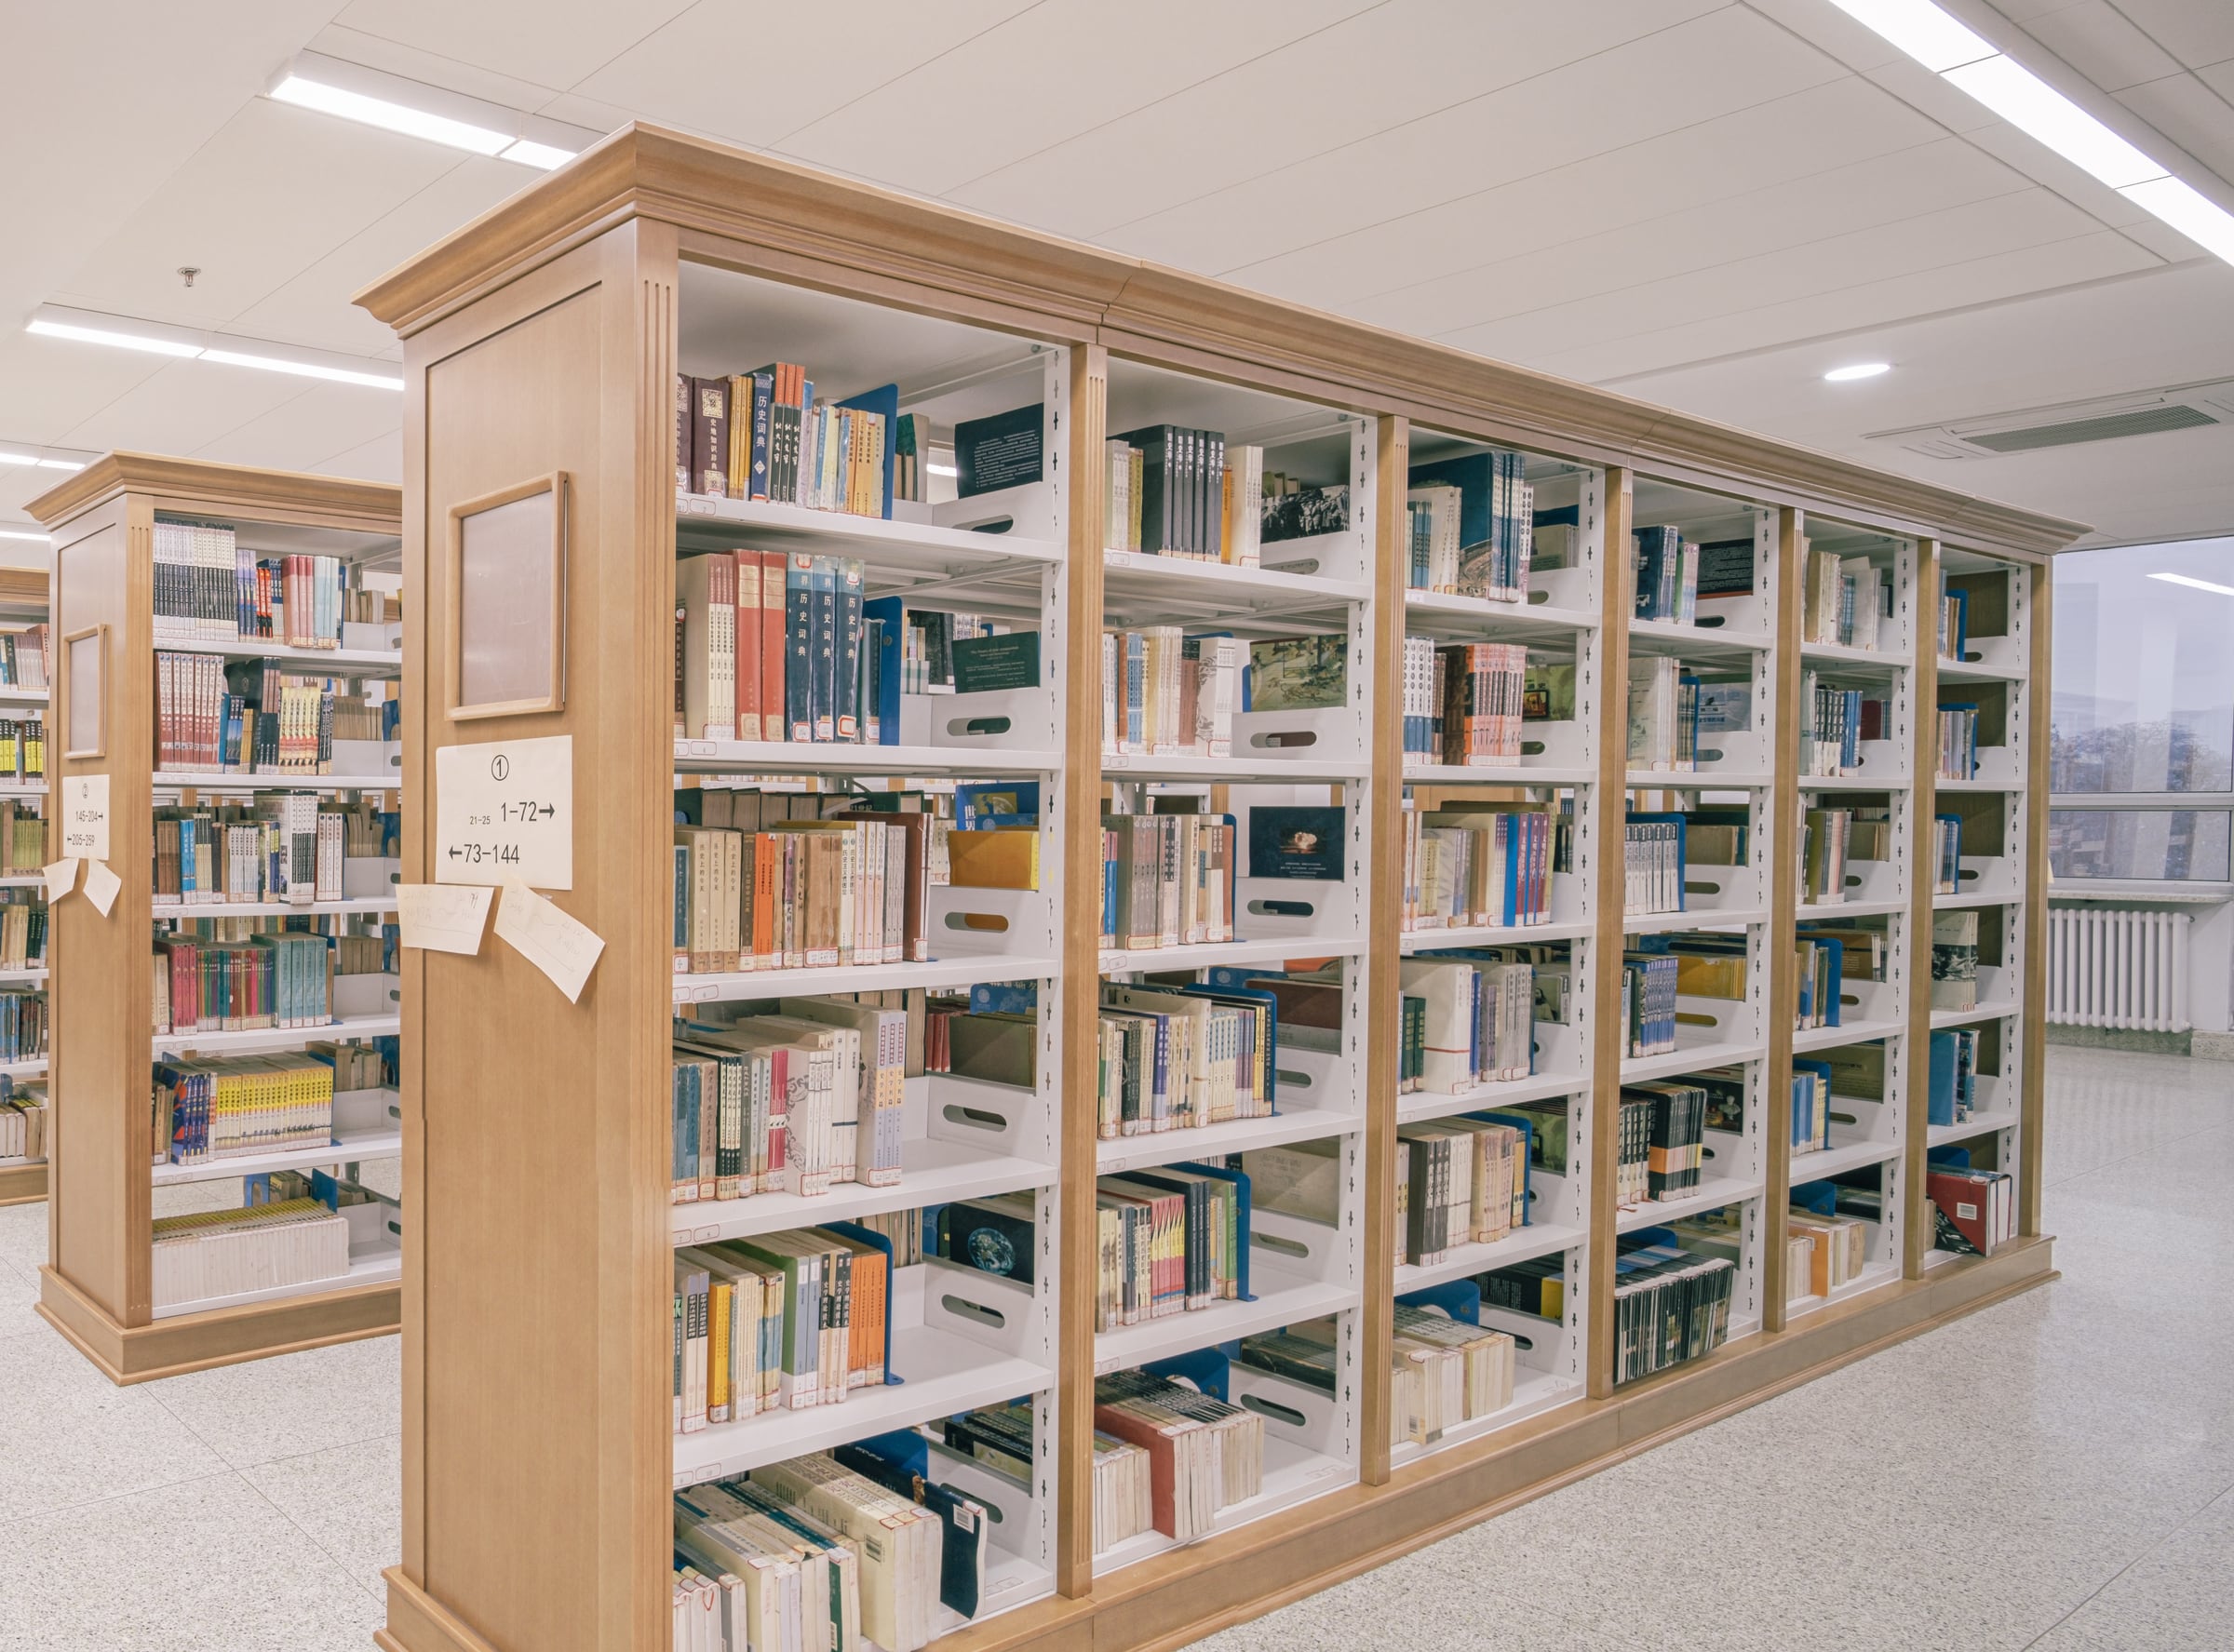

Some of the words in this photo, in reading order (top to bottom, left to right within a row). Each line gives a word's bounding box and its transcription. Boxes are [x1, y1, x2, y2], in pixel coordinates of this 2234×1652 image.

[756, 396, 768, 448] 历史词典
[469, 815, 491, 825] 21-25
[501, 800, 537, 822] 1-72
[464, 843, 519, 865] 73-144
